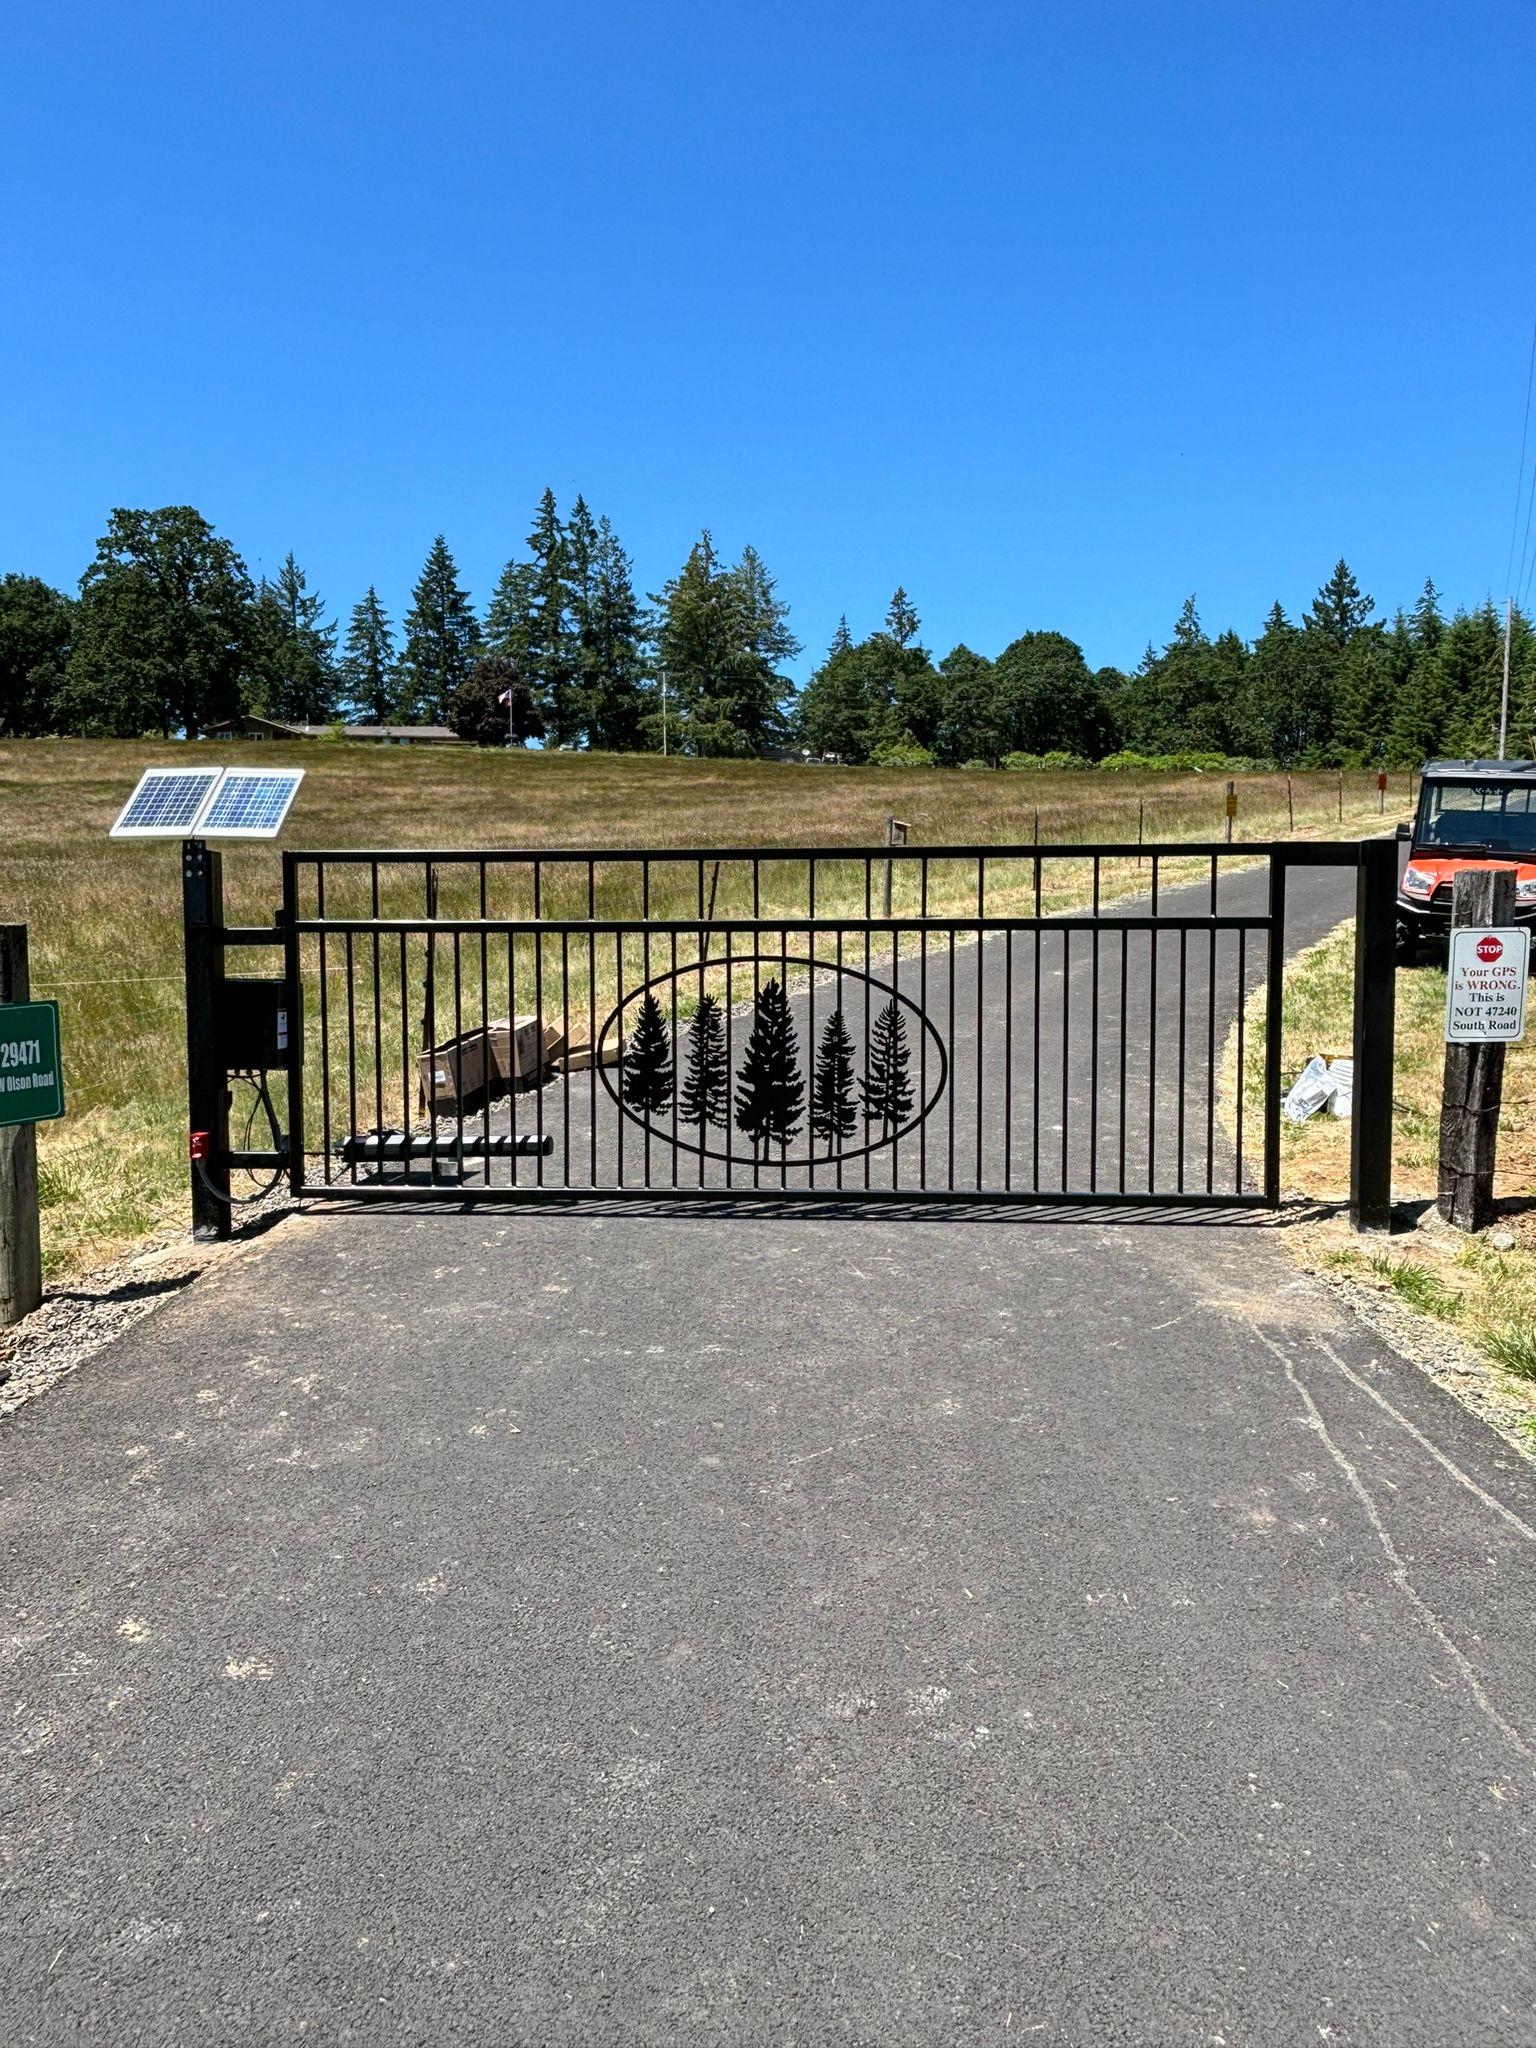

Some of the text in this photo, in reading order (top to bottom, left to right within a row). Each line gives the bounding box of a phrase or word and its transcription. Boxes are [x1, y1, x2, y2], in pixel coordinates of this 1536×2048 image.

[1477, 945, 1503, 954] STOP
[1461, 967, 1517, 977] Your GPS
[1455, 980, 1521, 990] is WRONG.
[1469, 993, 1505, 1002] This is
[1455, 1006, 1517, 1017] NOT 47240
[1453, 1020, 1516, 1030] South Road
[0, 1039, 41, 1068] 29471
[6, 1076, 31, 1091] Olson
[32, 1071, 54, 1088] Road
